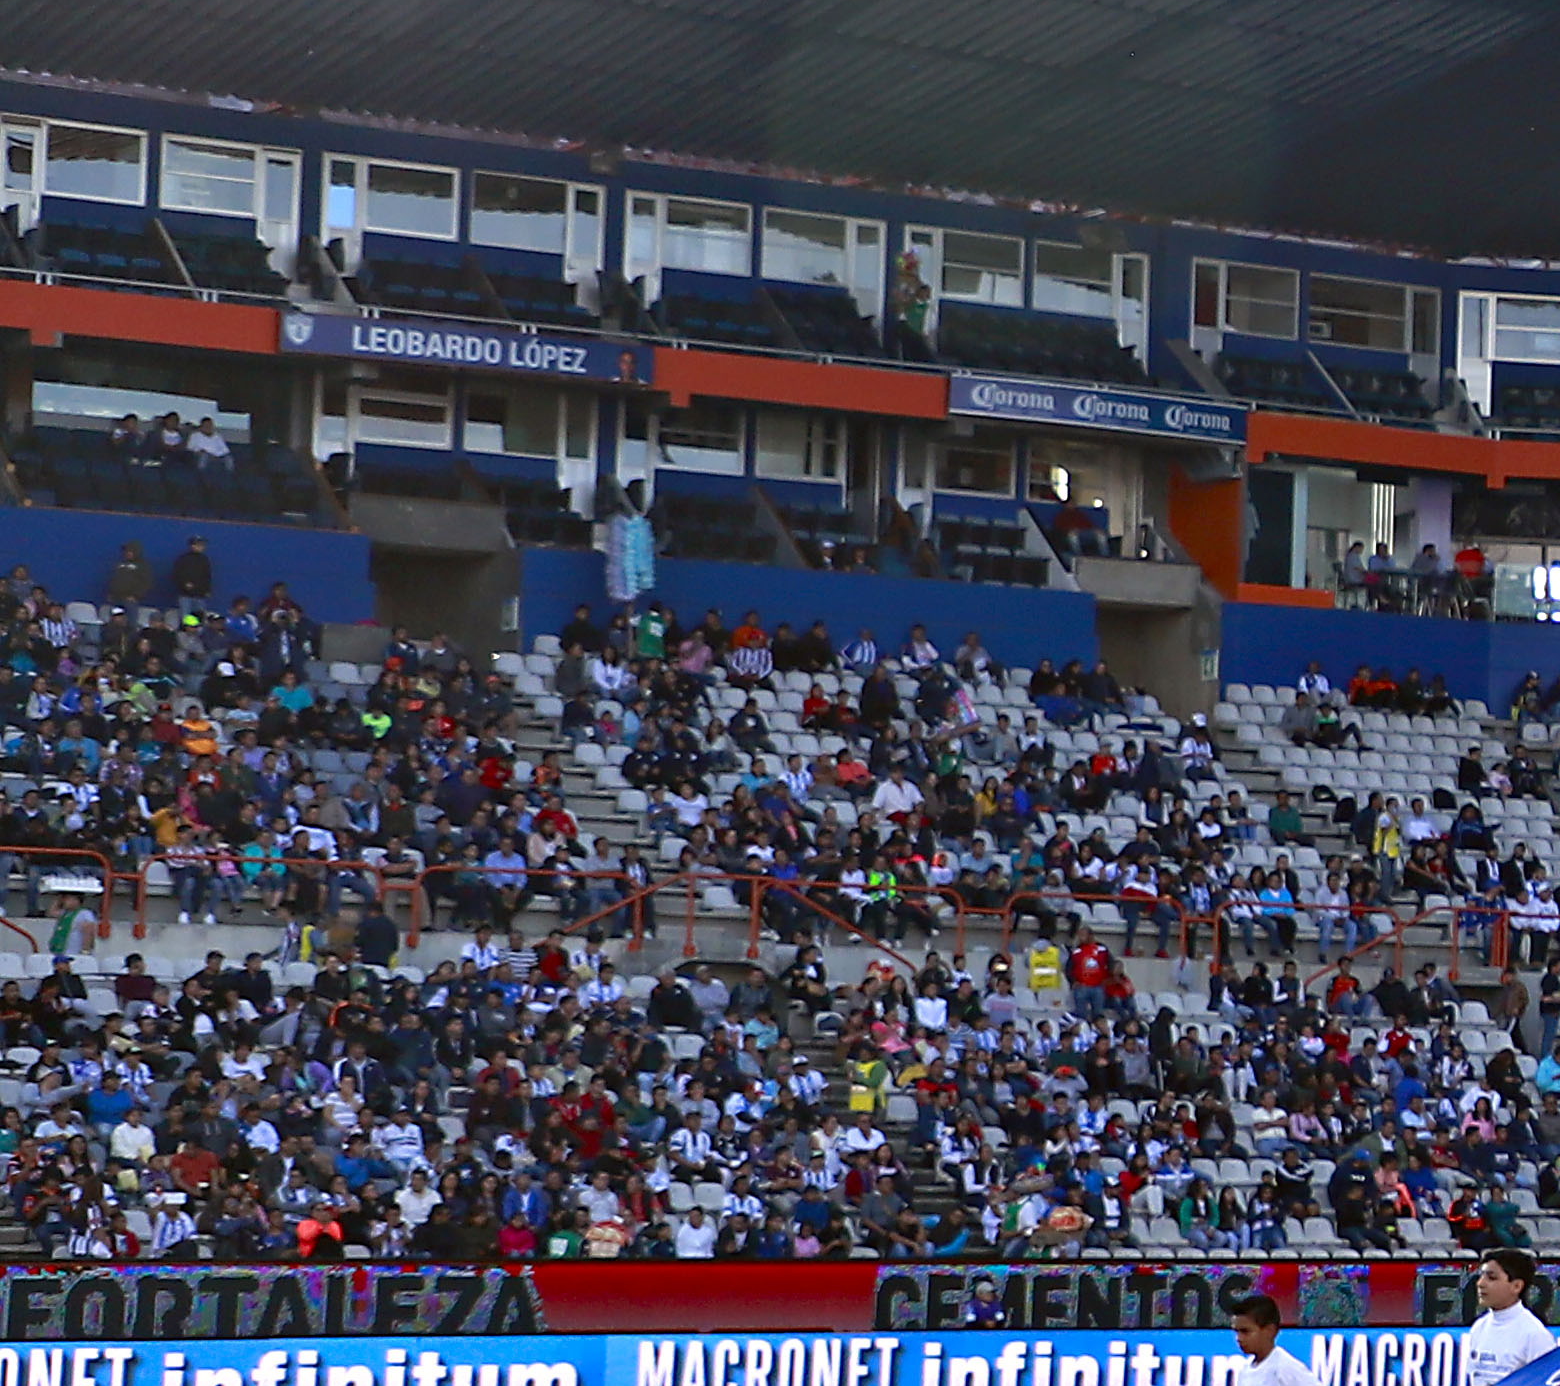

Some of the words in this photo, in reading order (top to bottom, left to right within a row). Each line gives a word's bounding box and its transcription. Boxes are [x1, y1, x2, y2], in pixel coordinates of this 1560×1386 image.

[352, 325, 501, 364] LEOBARDO
[509, 337, 588, 374] LÓPEZ
[970, 383, 1055, 411] Corona
[1073, 394, 1150, 422] Corona
[1164, 404, 1231, 432] Corona
[7, 1273, 540, 1338] FORTALEZA
